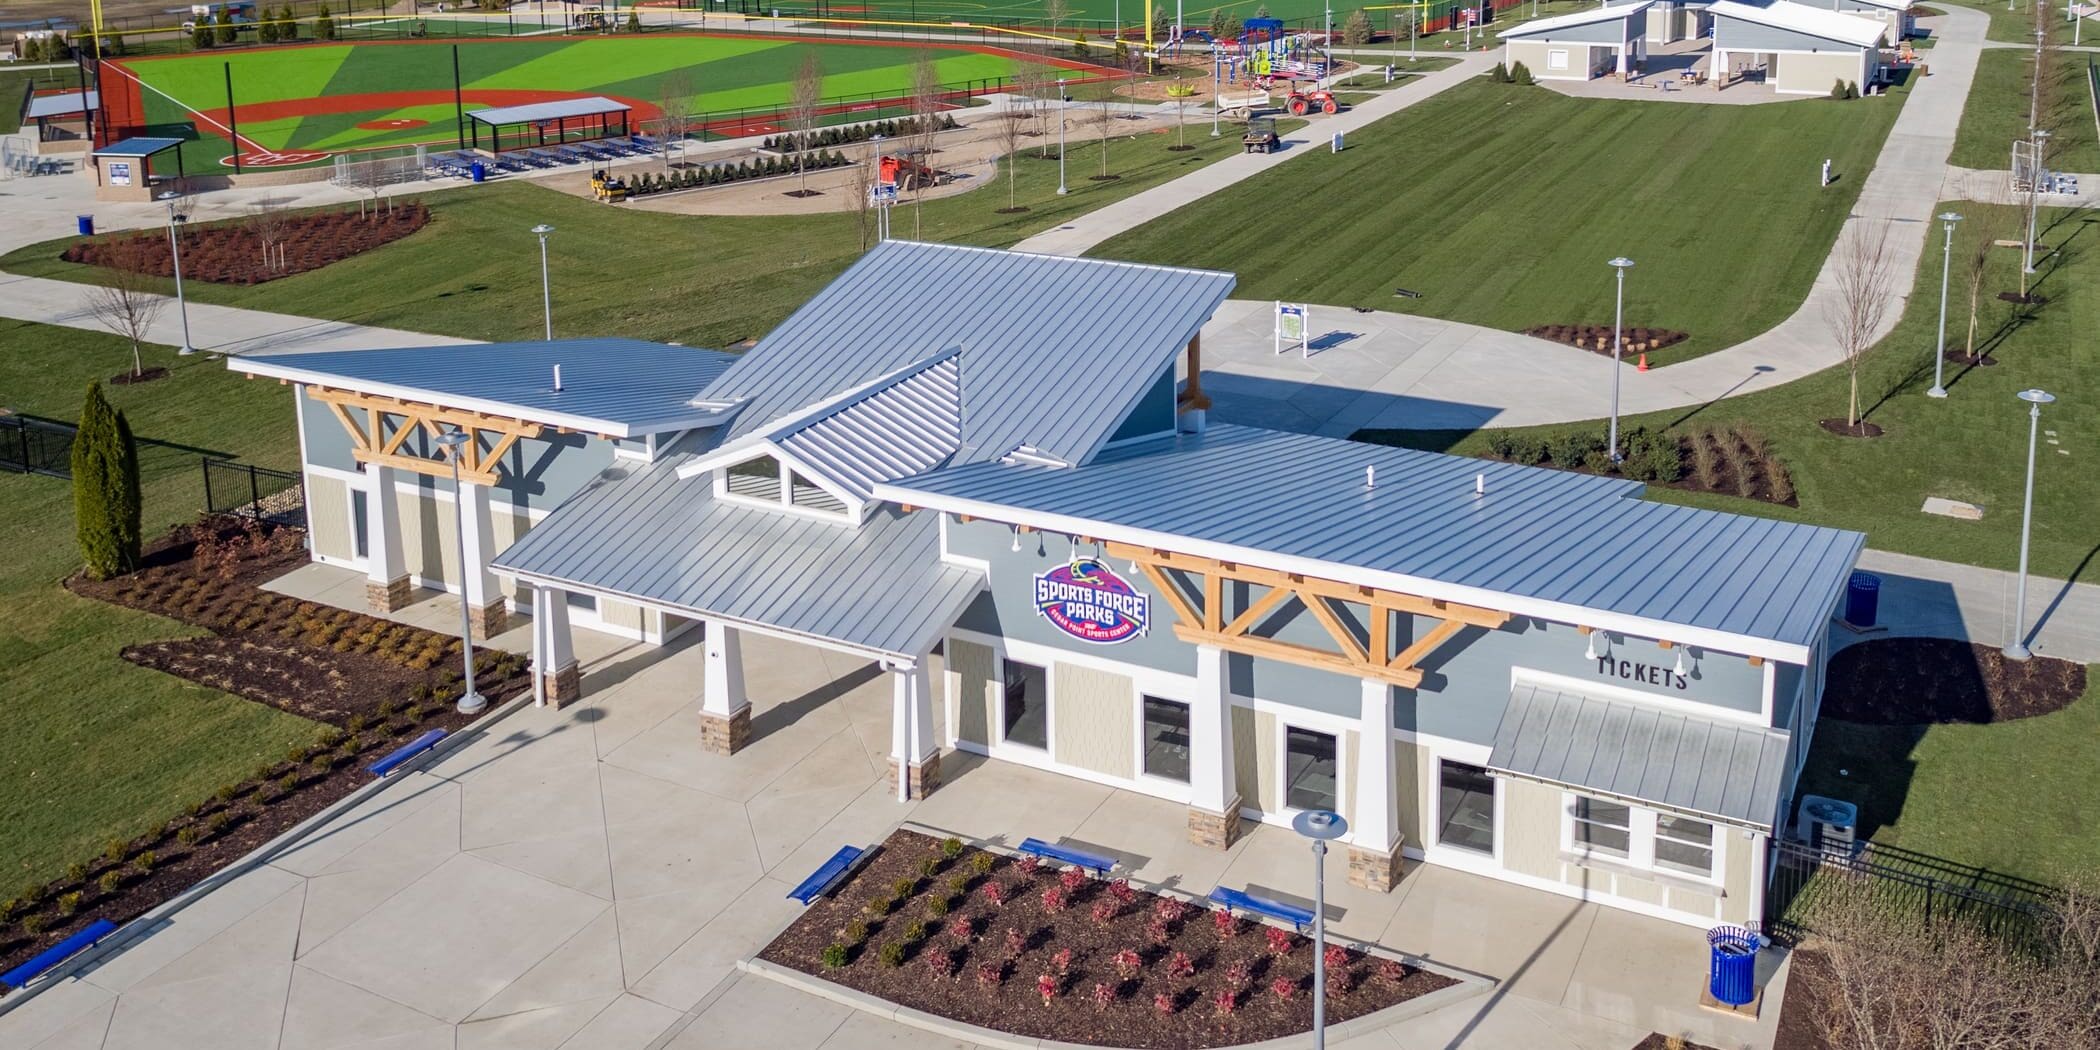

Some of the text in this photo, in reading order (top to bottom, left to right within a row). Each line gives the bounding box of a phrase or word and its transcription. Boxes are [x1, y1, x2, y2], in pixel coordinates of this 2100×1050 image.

[1038, 579, 1144, 622] SPORTS FORCE
[1066, 602, 1114, 625] PARKS
[1068, 623, 1086, 635] POINT
[1086, 629, 1109, 638] SPORTS
[1109, 623, 1131, 637] CENTER
[1597, 655, 1687, 690] TICKETS
